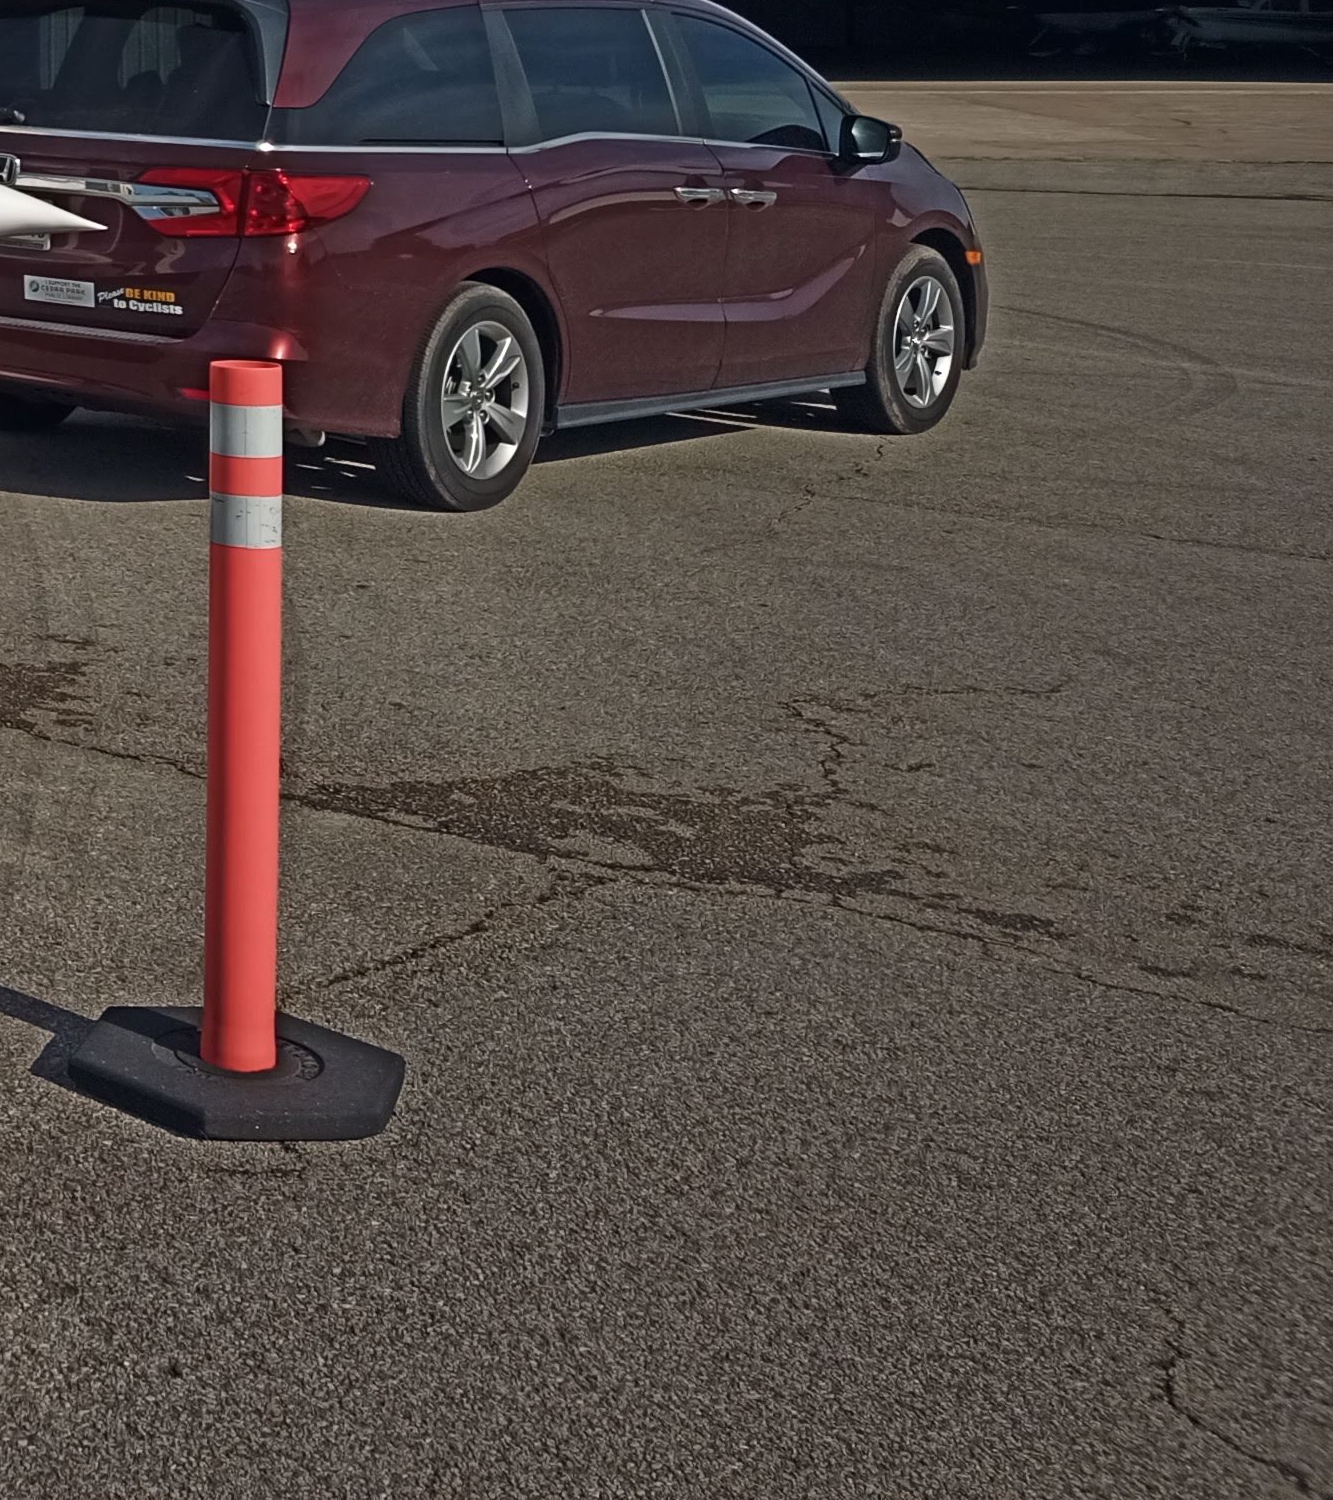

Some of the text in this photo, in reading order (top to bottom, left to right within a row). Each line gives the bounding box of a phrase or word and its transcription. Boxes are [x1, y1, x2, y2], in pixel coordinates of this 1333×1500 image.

[97, 288, 175, 303] Please BE KIND
[113, 299, 183, 315] to Cyclists
